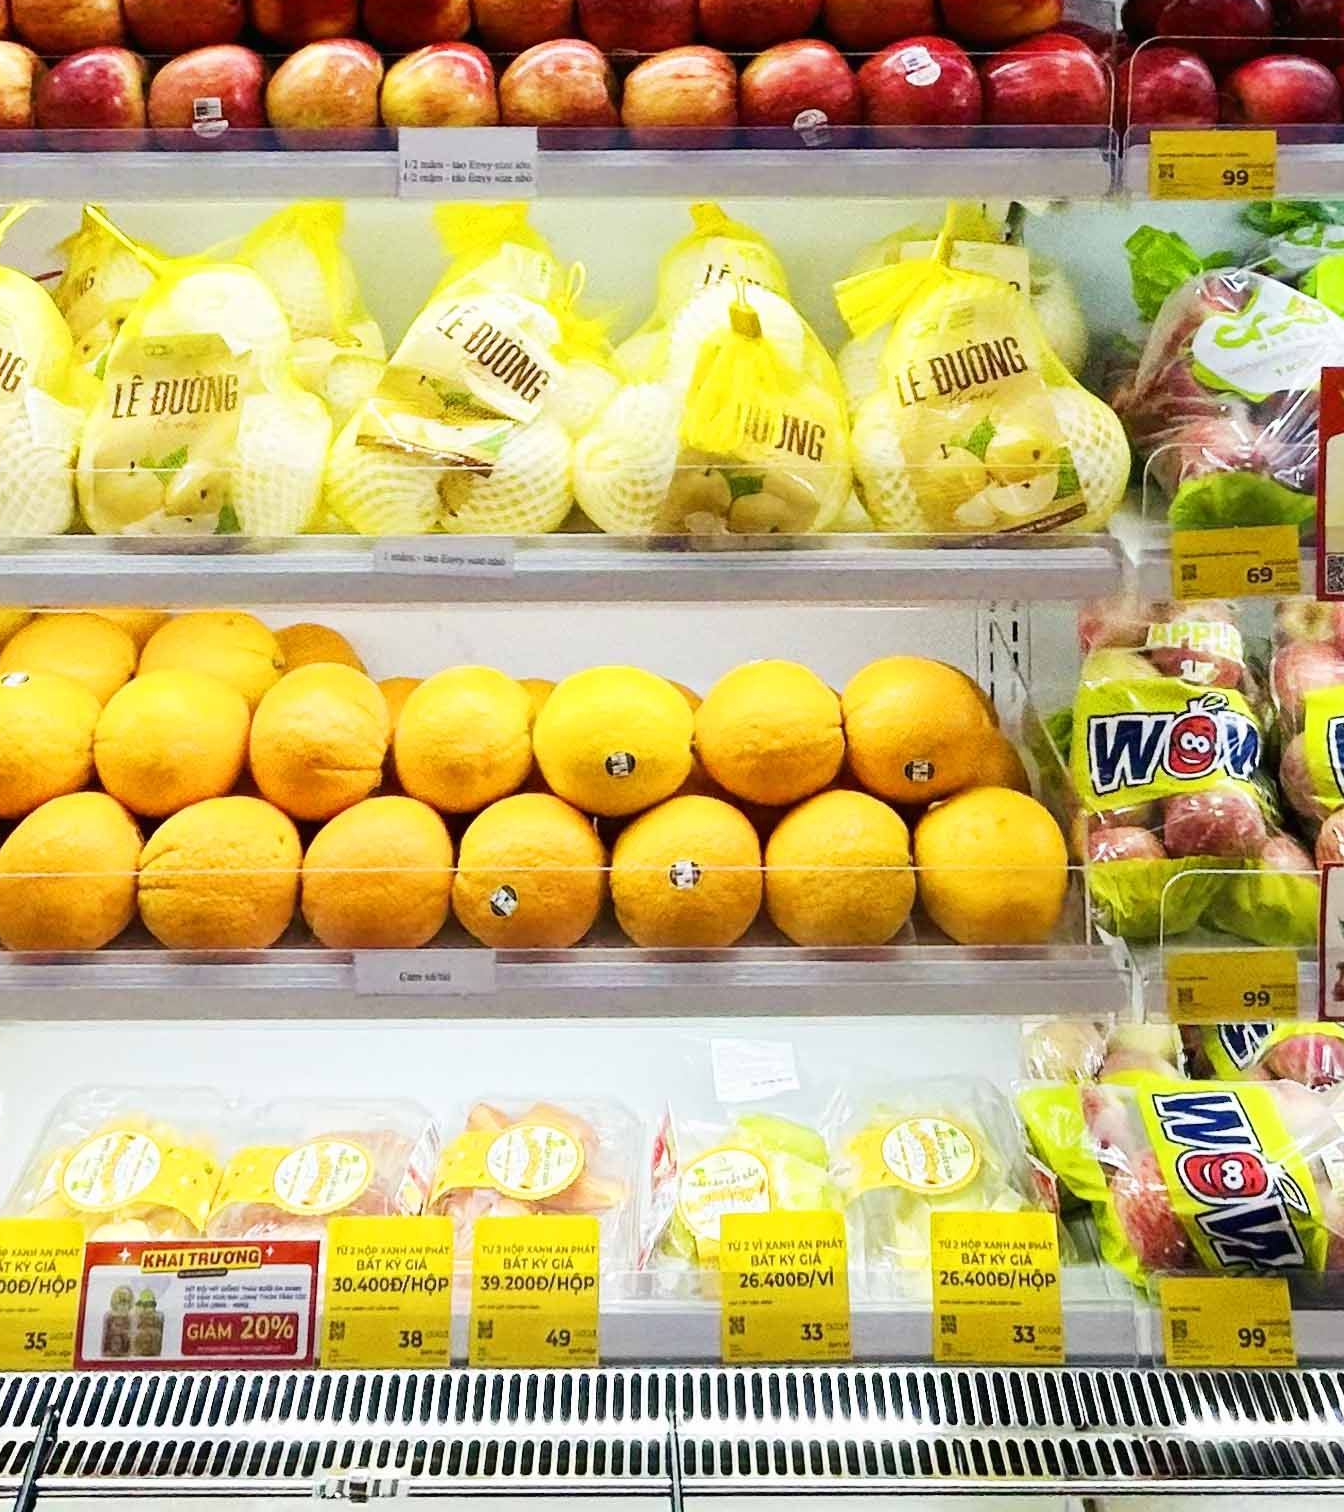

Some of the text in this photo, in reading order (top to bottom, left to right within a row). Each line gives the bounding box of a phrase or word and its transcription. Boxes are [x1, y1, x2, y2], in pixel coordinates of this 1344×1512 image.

[1222, 169, 1249, 187] 99
[111, 374, 145, 419] LÊ
[1246, 566, 1274, 584] 69
[1242, 990, 1271, 1008] 99
[34, 1260, 57, 1273] GIÁ
[143, 1249, 260, 1268] KHAI TRƯƠNG
[405, 1258, 427, 1271] GIÁ
[551, 1257, 574, 1270] GIÁ
[799, 1253, 822, 1266] GIÁ
[1009, 1252, 1033, 1265] GIÁ
[331, 1274, 449, 1297] 30.400Đ/HỘP
[480, 1273, 595, 1296] 39.200Đ/HỘP
[739, 1267, 835, 1289] 26.400Đ/VỈ
[939, 1268, 1057, 1292] 26.400Đ/HỘP
[186, 1315, 294, 1340] GIẢM 20%
[800, 1322, 824, 1341] 33
[1012, 1324, 1036, 1343] 33
[24, 1332, 47, 1350] 35
[398, 1330, 423, 1348] 38
[545, 1330, 571, 1347] 49
[1237, 1327, 1266, 1348] 99
